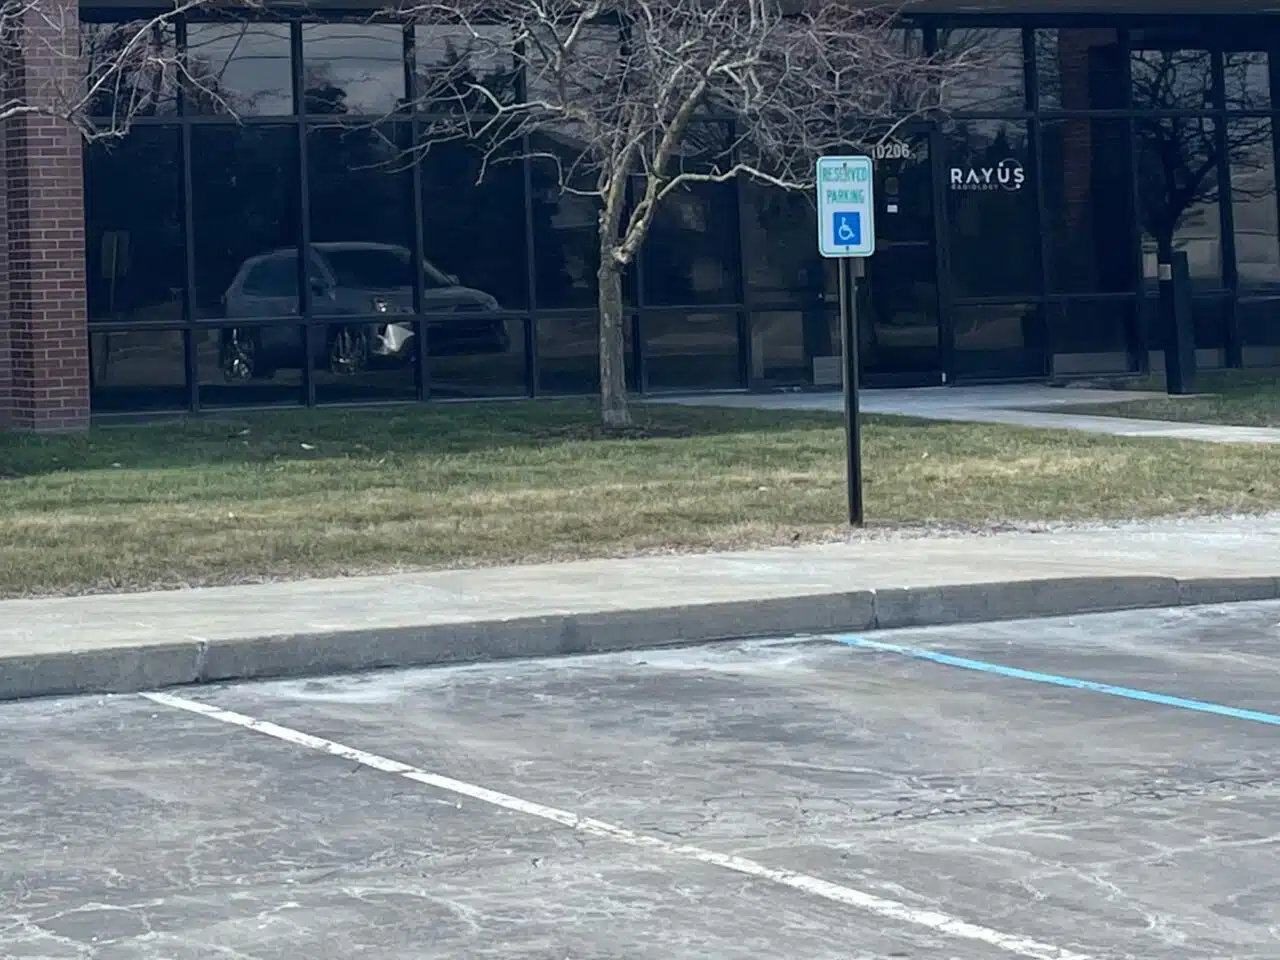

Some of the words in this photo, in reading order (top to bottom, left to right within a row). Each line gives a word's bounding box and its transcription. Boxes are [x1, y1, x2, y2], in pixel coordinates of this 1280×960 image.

[821, 167, 869, 182] RESERVED
[950, 167, 1025, 184] RAYUS
[826, 189, 865, 204] PARKING
